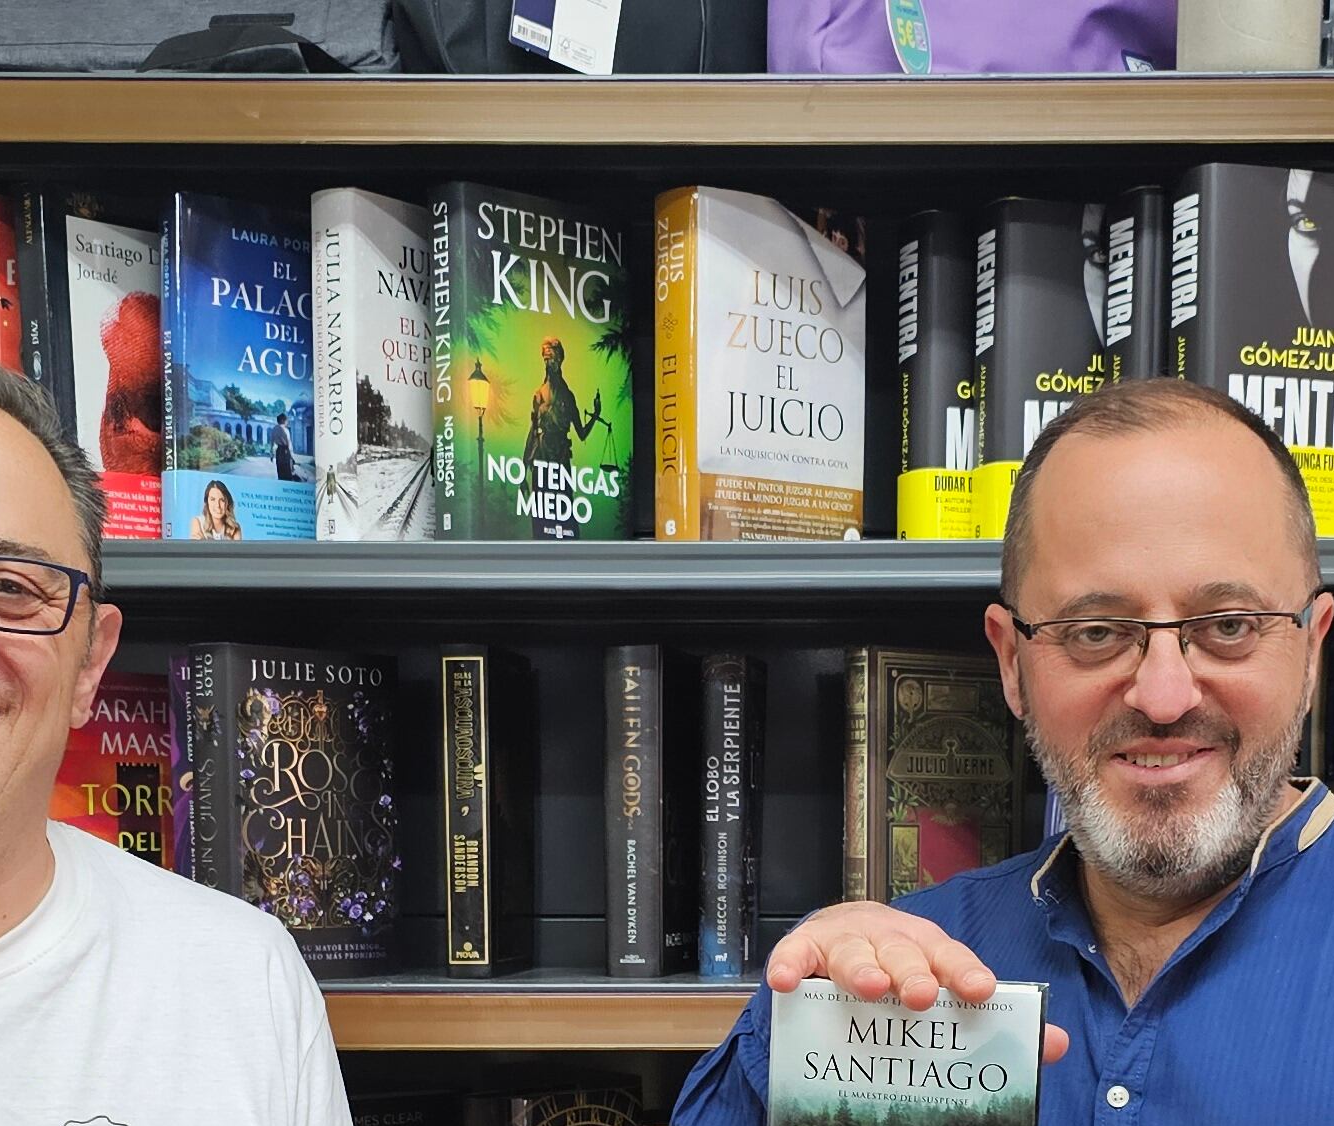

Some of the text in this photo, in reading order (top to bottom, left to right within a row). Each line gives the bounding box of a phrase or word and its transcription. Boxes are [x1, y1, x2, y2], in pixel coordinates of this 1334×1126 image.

[75, 234, 143, 267] Santiago
[477, 202, 623, 268] STEPHEN
[77, 263, 118, 286] Jotadé
[1171, 193, 1199, 329] MENTIRA
[491, 250, 611, 325] KING
[753, 270, 822, 316] LUIS
[727, 312, 843, 364] ZUECO
[776, 365, 799, 392] EL
[727, 392, 843, 441] JUICIO
[488, 455, 620, 498] NO TENGAS
[516, 488, 592, 524] MIEDO
[251, 659, 383, 687] JULIE SOTO
[847, 1016, 967, 1051] MIKEL
[804, 1051, 1008, 1093] SANTIAGO
[839, 1090, 969, 1106] EL MAESTRO DEL SUSPENSE
